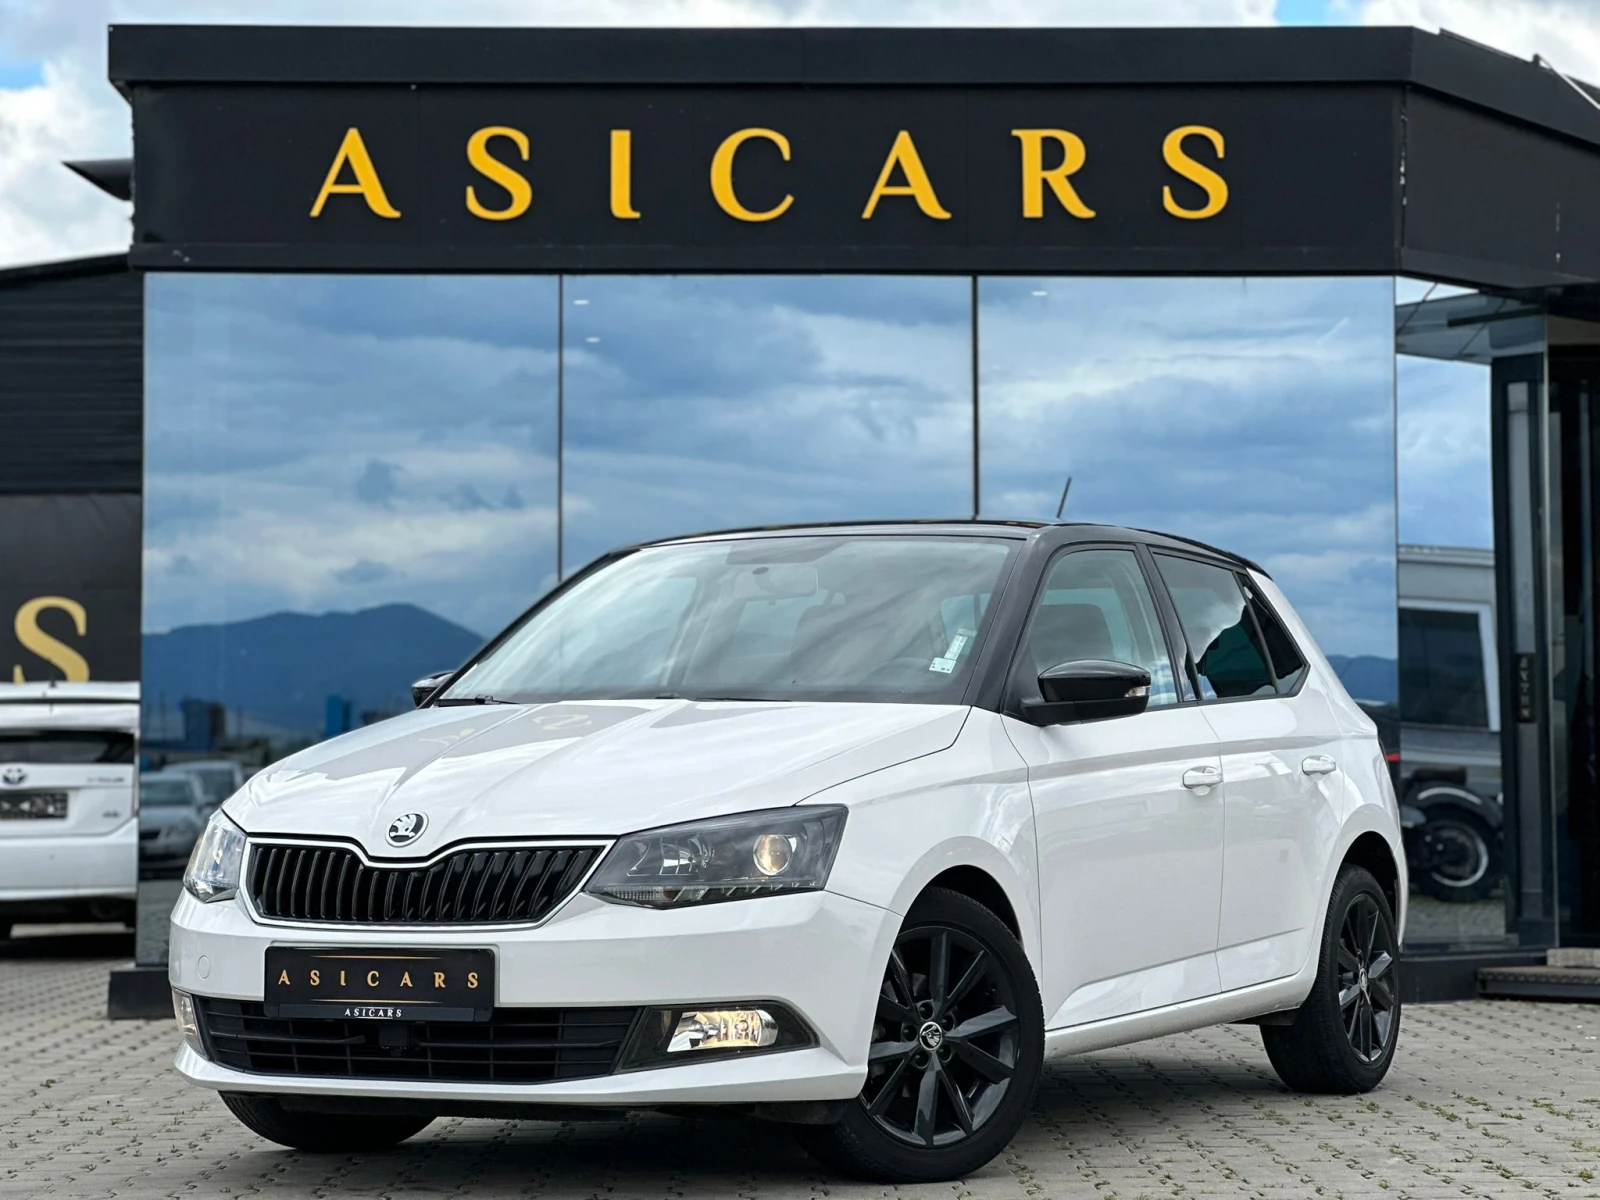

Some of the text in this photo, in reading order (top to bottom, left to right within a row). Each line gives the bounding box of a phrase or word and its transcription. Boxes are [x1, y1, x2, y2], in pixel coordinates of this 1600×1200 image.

[310, 126, 1229, 221] ASICARS
[278, 969, 479, 989] ASICARS
[344, 1007, 402, 1018] ASICARS
